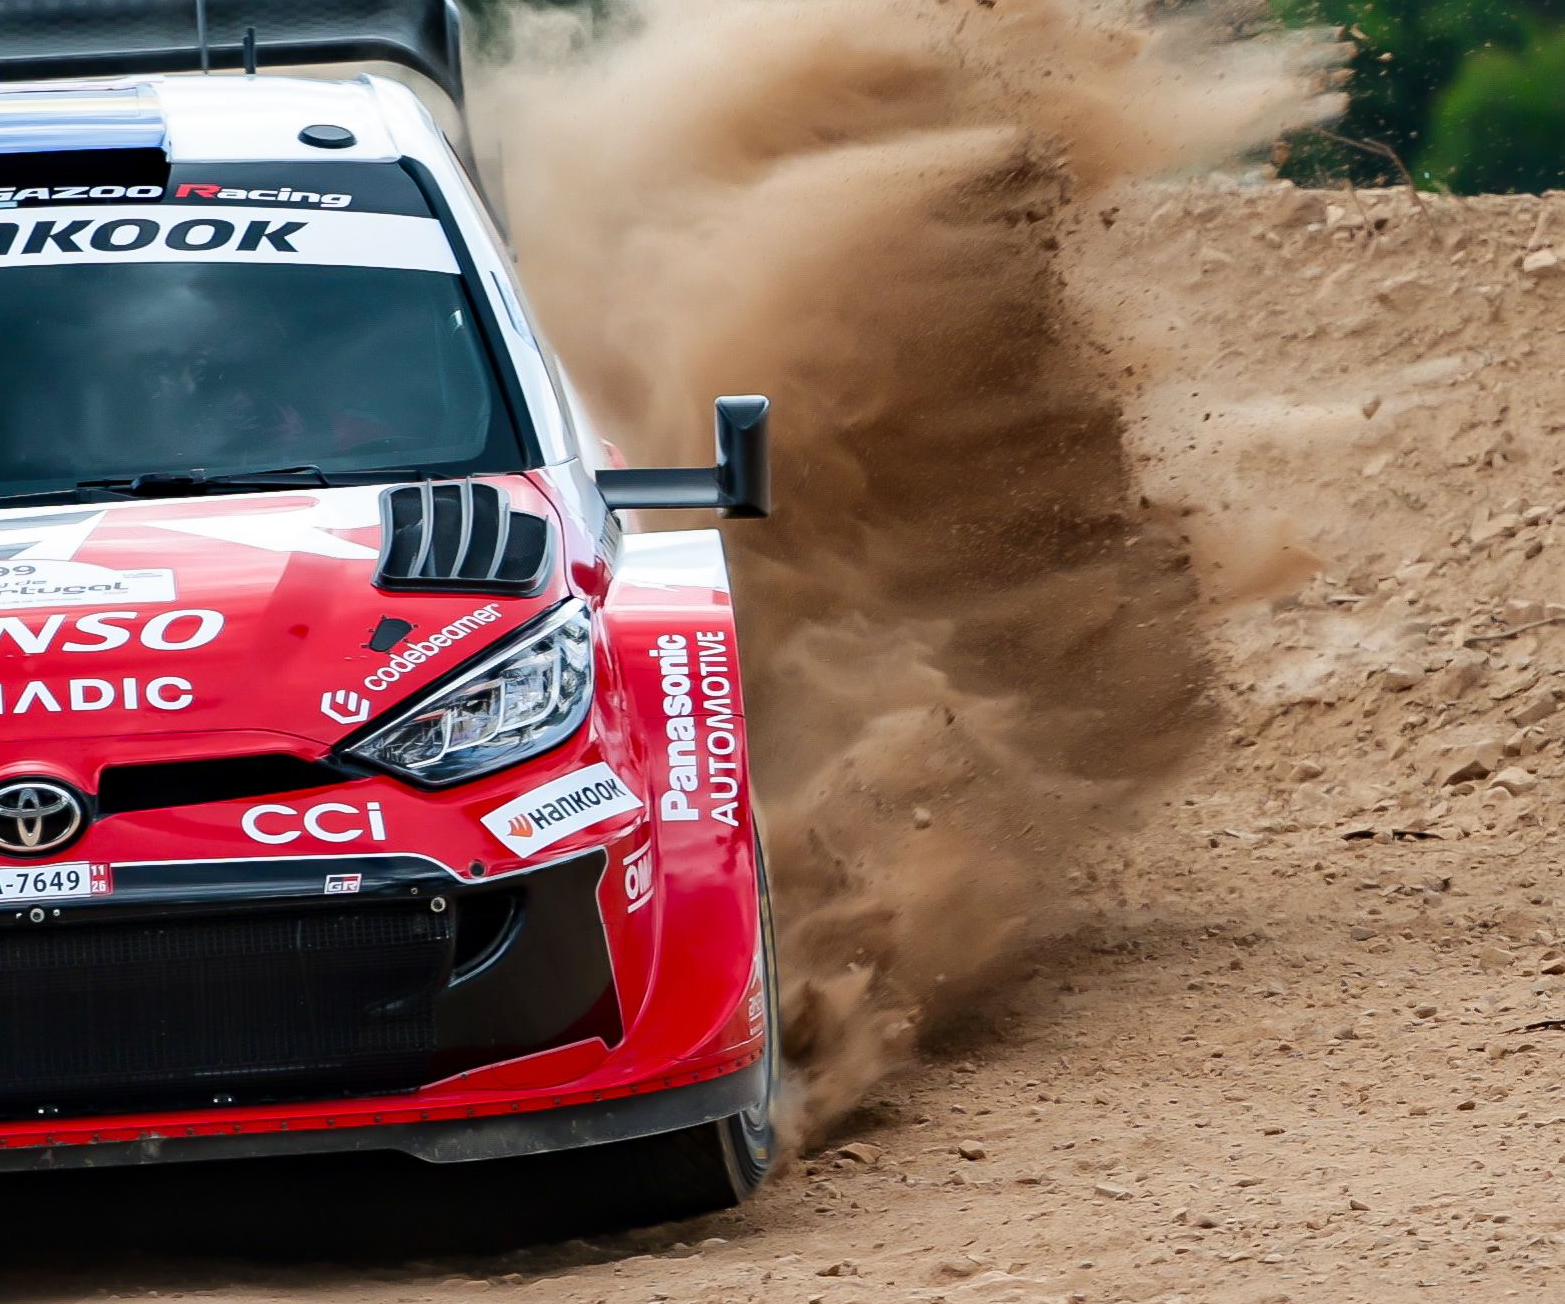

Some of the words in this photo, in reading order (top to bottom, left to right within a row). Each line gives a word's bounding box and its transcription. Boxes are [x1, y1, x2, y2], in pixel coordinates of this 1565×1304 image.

[175, 183, 352, 208] Racing
[363, 602, 503, 692] codebeamer
[649, 633, 700, 823] Panasonic
[696, 630, 739, 828] AUTOMOTIVE
[91, 864, 105, 876] 11
[91, 880, 107, 893] 26
[328, 880, 358, 892] GR
[625, 850, 653, 900] OM
